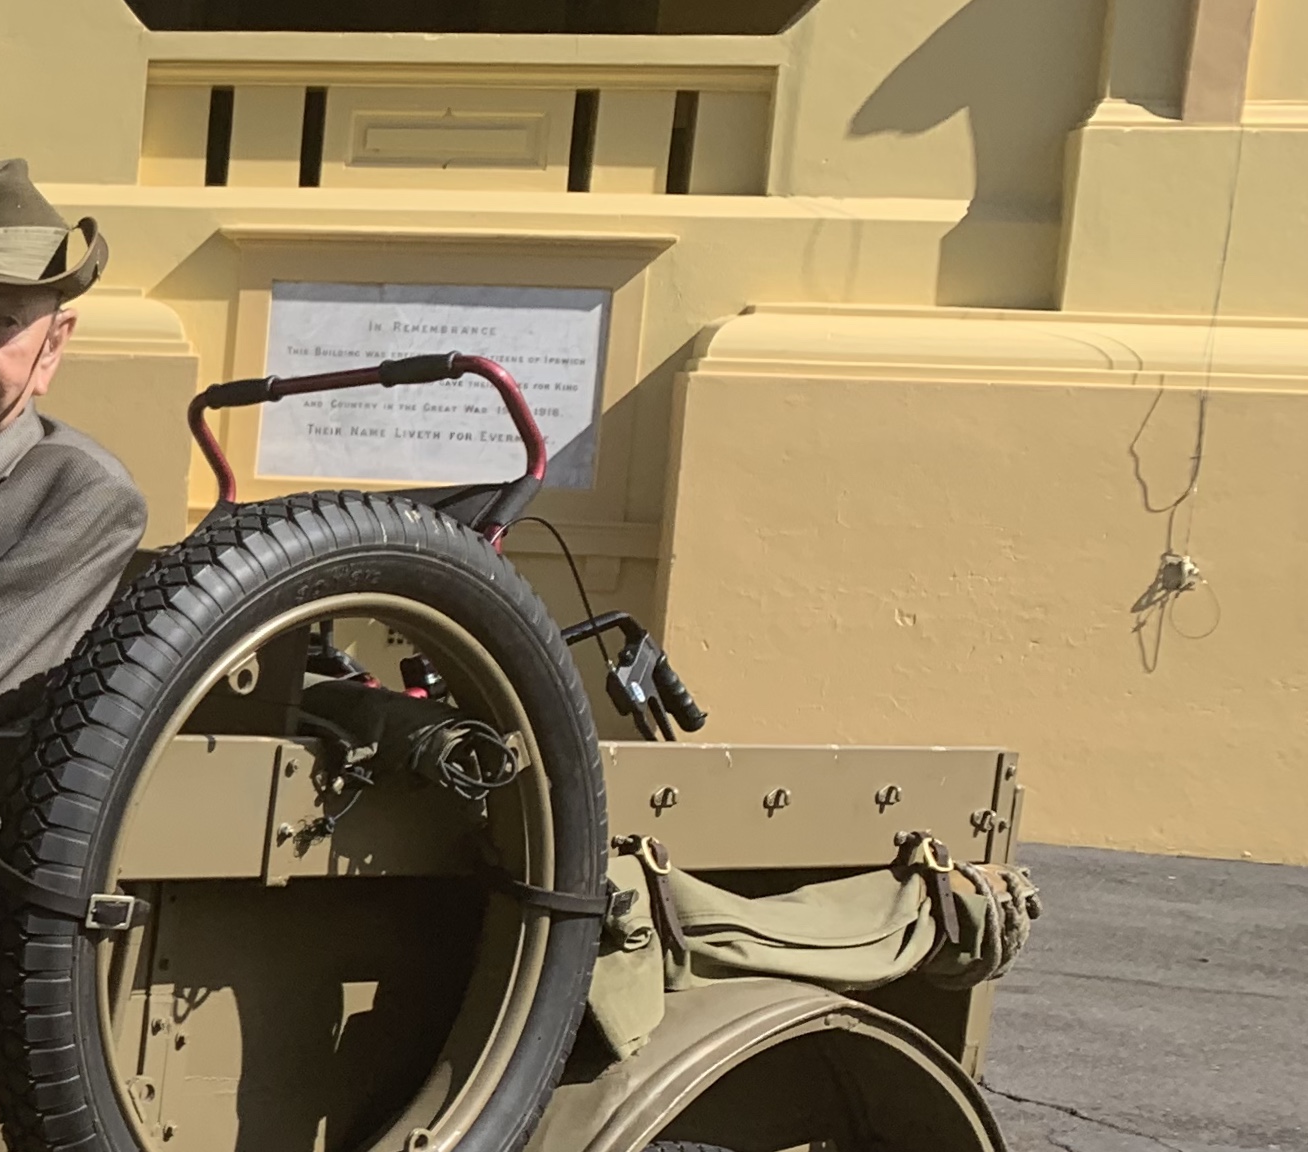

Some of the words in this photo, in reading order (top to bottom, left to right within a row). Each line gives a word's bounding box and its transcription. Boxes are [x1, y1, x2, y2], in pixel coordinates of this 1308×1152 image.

[368, 320, 383, 332] IN
[393, 320, 497, 336] REMEMBRANCE
[287, 345, 309, 356] THIS
[314, 346, 361, 358] BUILDING
[544, 355, 586, 366] IPSWICH
[555, 382, 579, 392] KING
[330, 400, 378, 410] COUNTRY
[399, 404, 417, 412] THE
[424, 403, 458, 413] GREAT
[465, 404, 488, 414] WAR
[307, 424, 342, 436] THEIR
[350, 426, 386, 438] NAME
[395, 428, 441, 440] LIVETH
[449, 431, 473, 441] FOR
